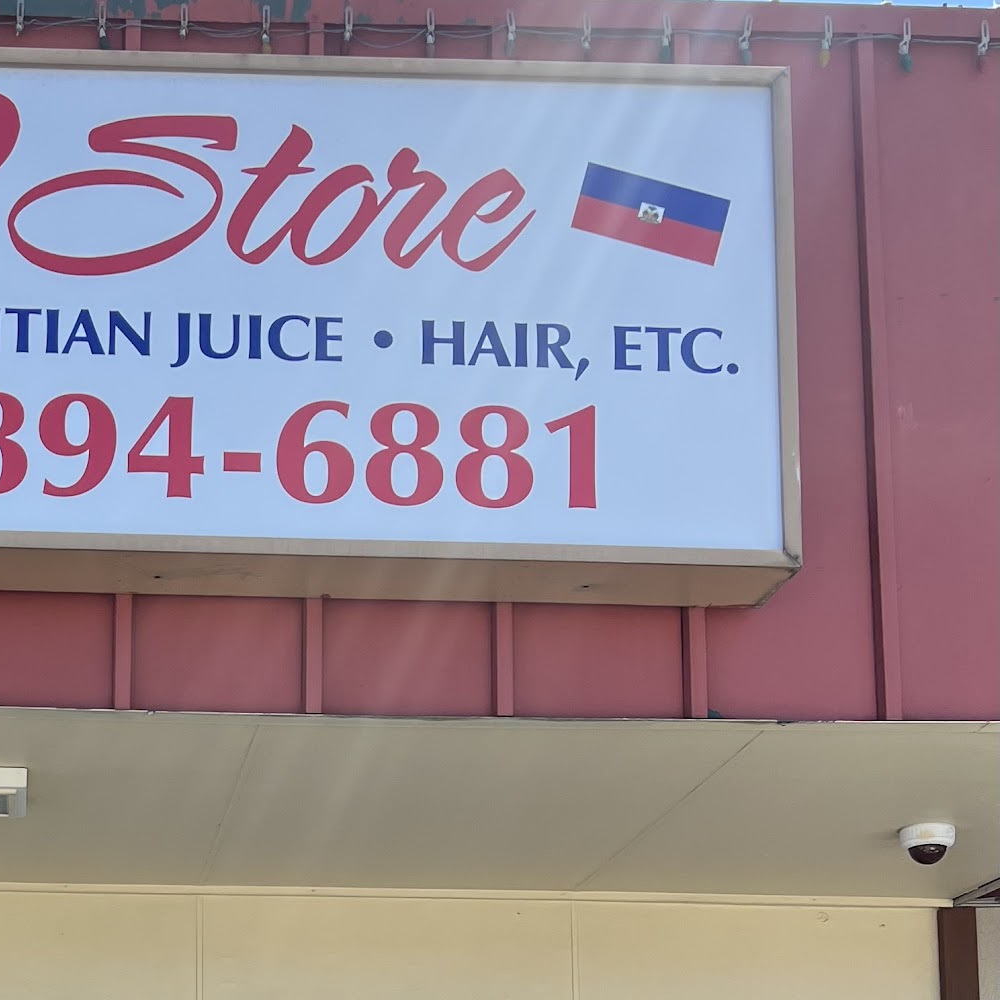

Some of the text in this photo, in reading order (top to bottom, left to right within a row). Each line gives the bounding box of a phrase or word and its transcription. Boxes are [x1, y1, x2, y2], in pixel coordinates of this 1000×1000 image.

[8, 115, 536, 275] Store
[169, 312, 344, 369] JUICE
[421, 319, 590, 382] HAIR,
[613, 325, 739, 375] ETC.
